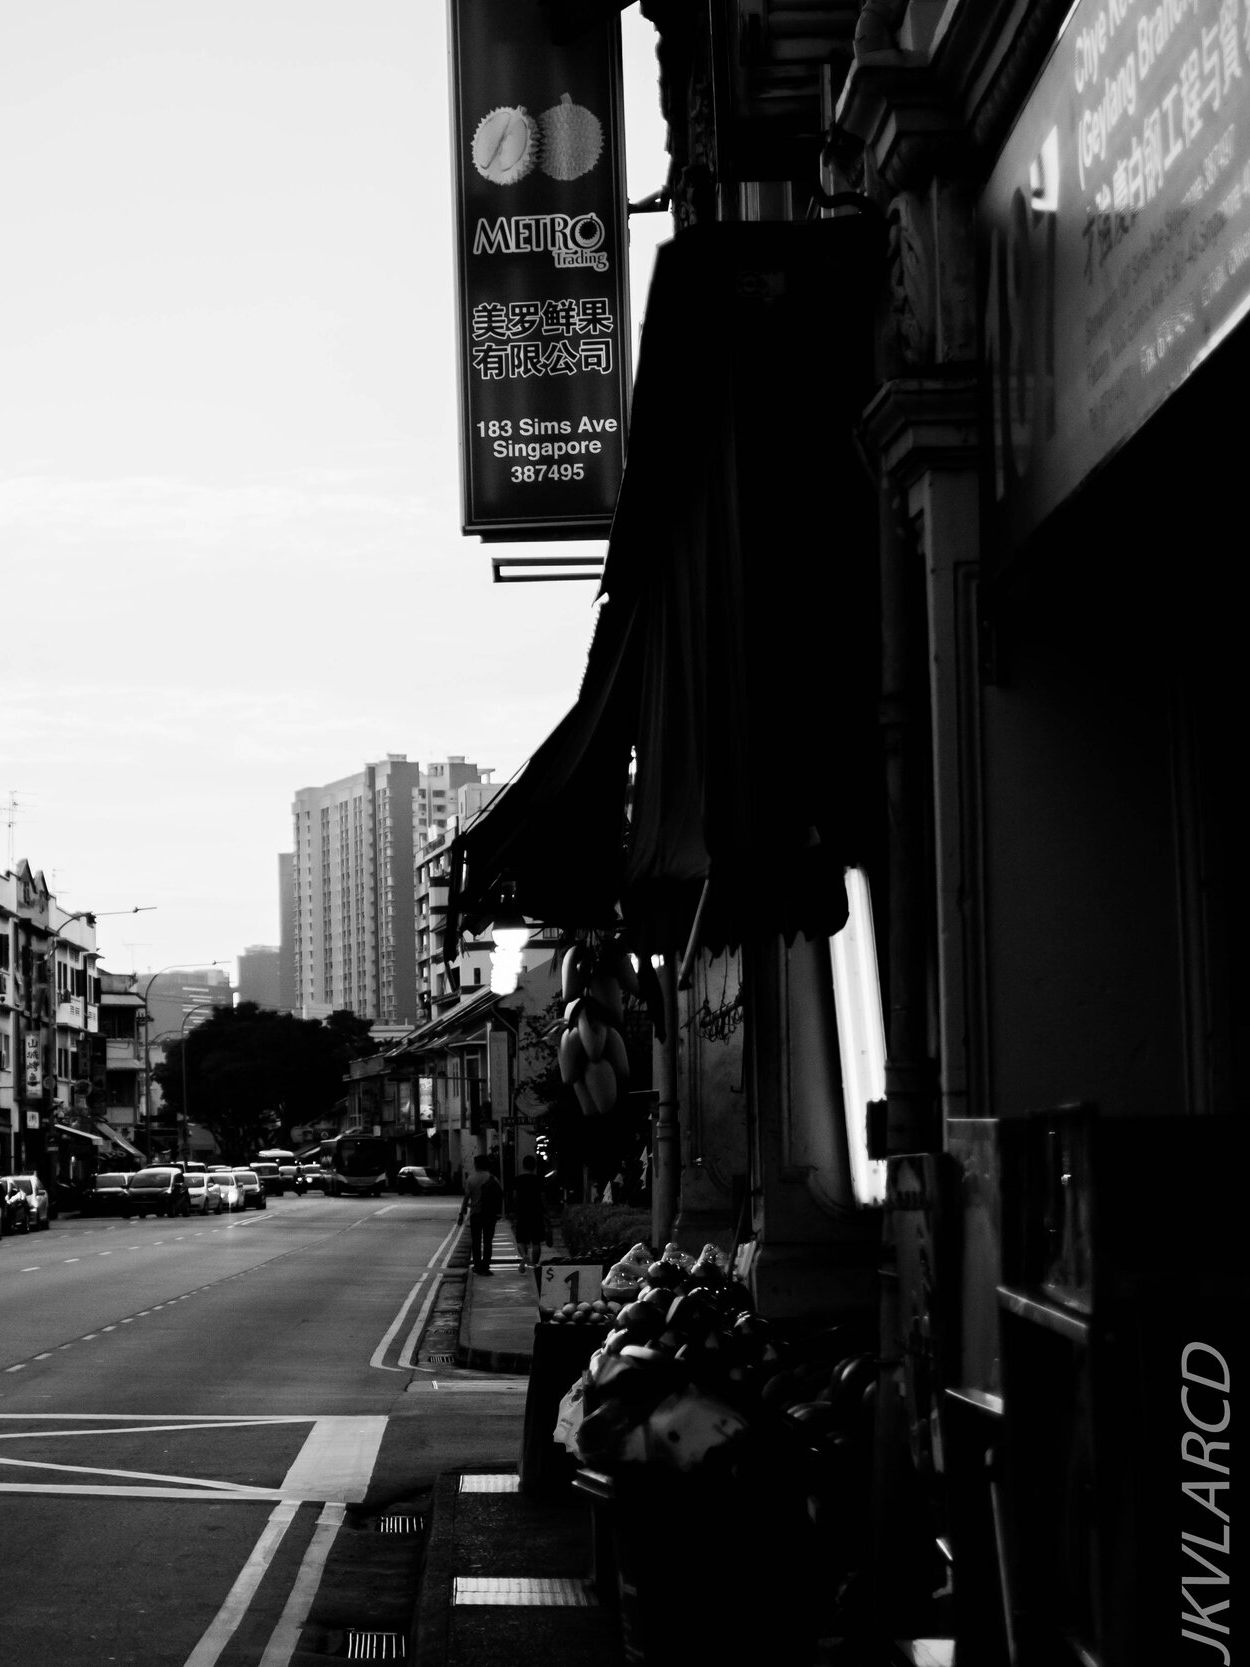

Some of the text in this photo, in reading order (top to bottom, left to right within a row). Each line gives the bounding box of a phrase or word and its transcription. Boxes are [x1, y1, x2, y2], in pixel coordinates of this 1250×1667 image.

[1075, 10, 1107, 94] Chye
[1078, 51, 1137, 191] (Geylang
[473, 212, 605, 255] METRO
[552, 250, 610, 272] Trading
[472, 298, 614, 341] 美罗鲜果
[472, 338, 613, 380] 有限公司
[476, 415, 619, 439] 183 Sims Ave
[492, 437, 603, 460] Singapore
[510, 463, 585, 484] 387495
